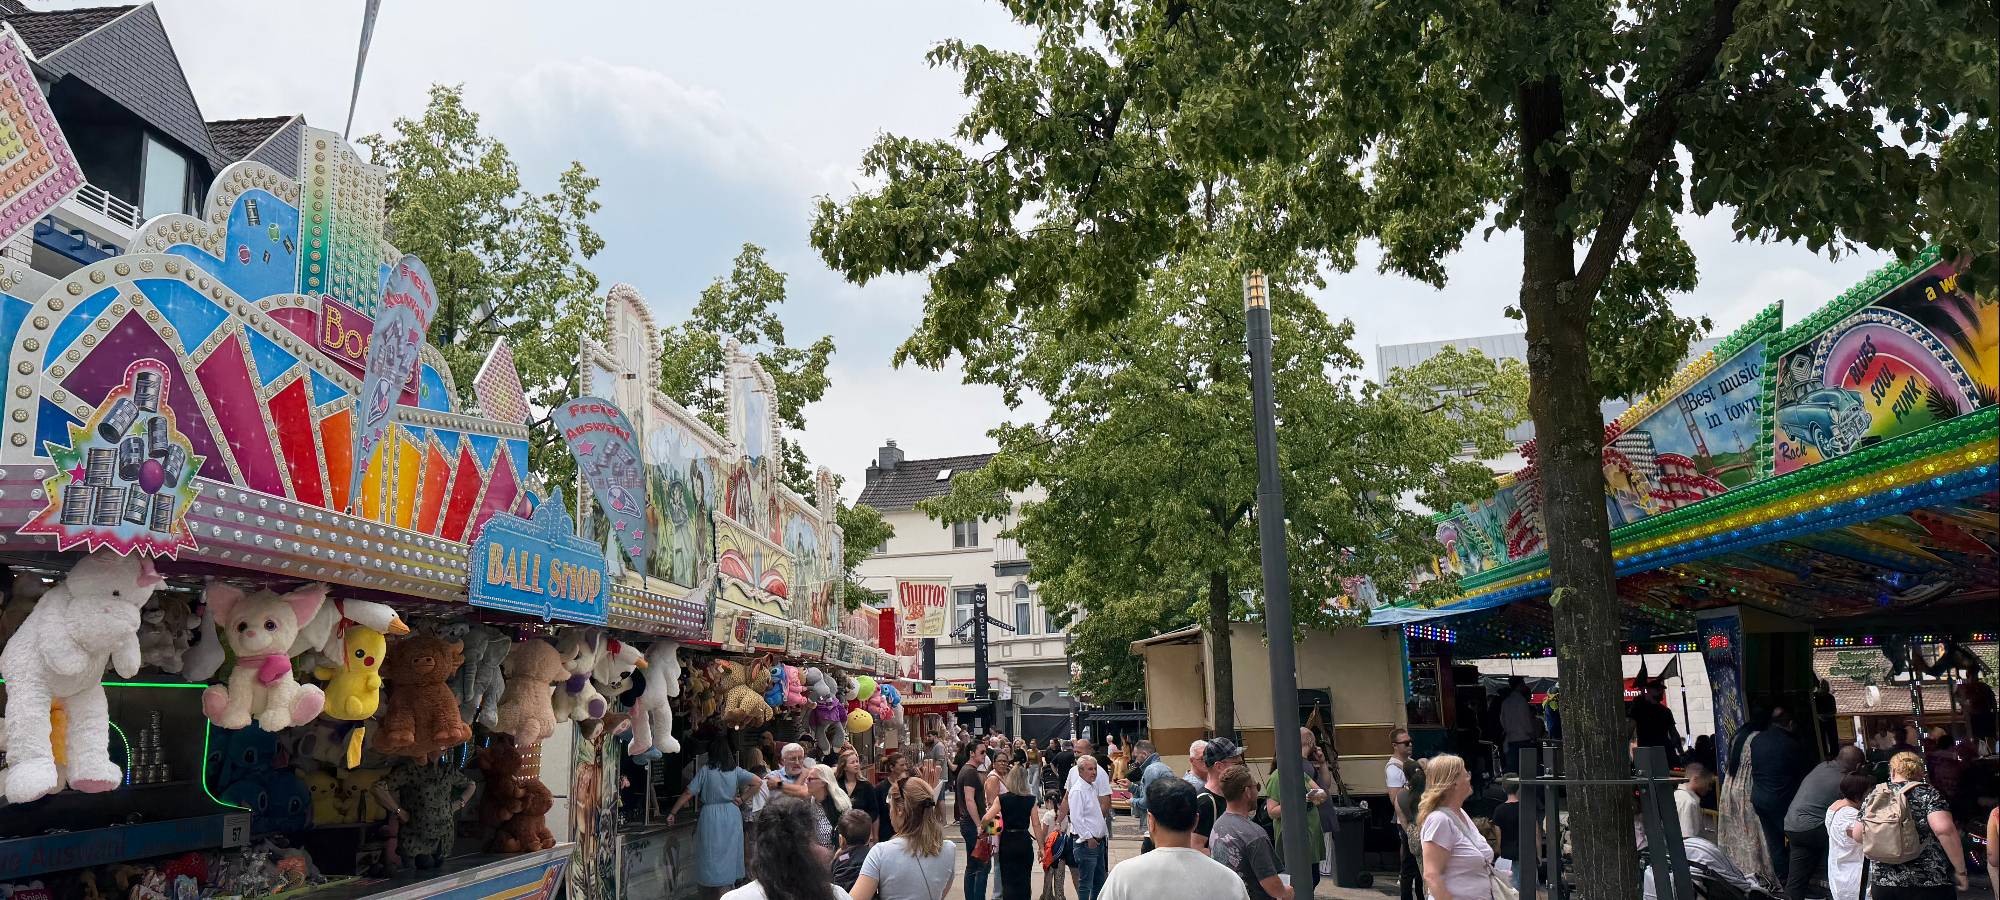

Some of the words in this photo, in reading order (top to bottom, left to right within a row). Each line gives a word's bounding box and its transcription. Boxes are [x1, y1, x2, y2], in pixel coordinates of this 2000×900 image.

[1849, 334, 1877, 385] BLUES
[1685, 385, 1717, 412] Best
[1718, 362, 1760, 395] music
[1870, 362, 1896, 406] SOUL
[1891, 375, 1922, 425] FUNK
[565, 422, 631, 441] Auswahl
[568, 402, 620, 418] Freie
[1704, 411, 1723, 429] in
[1724, 396, 1761, 421] town
[487, 542, 544, 594] BALL
[548, 558, 600, 604] SHOP
[900, 581, 947, 608] Churros
[979, 611, 989, 668] COCKTAILS
[232, 827, 242, 842] 57
